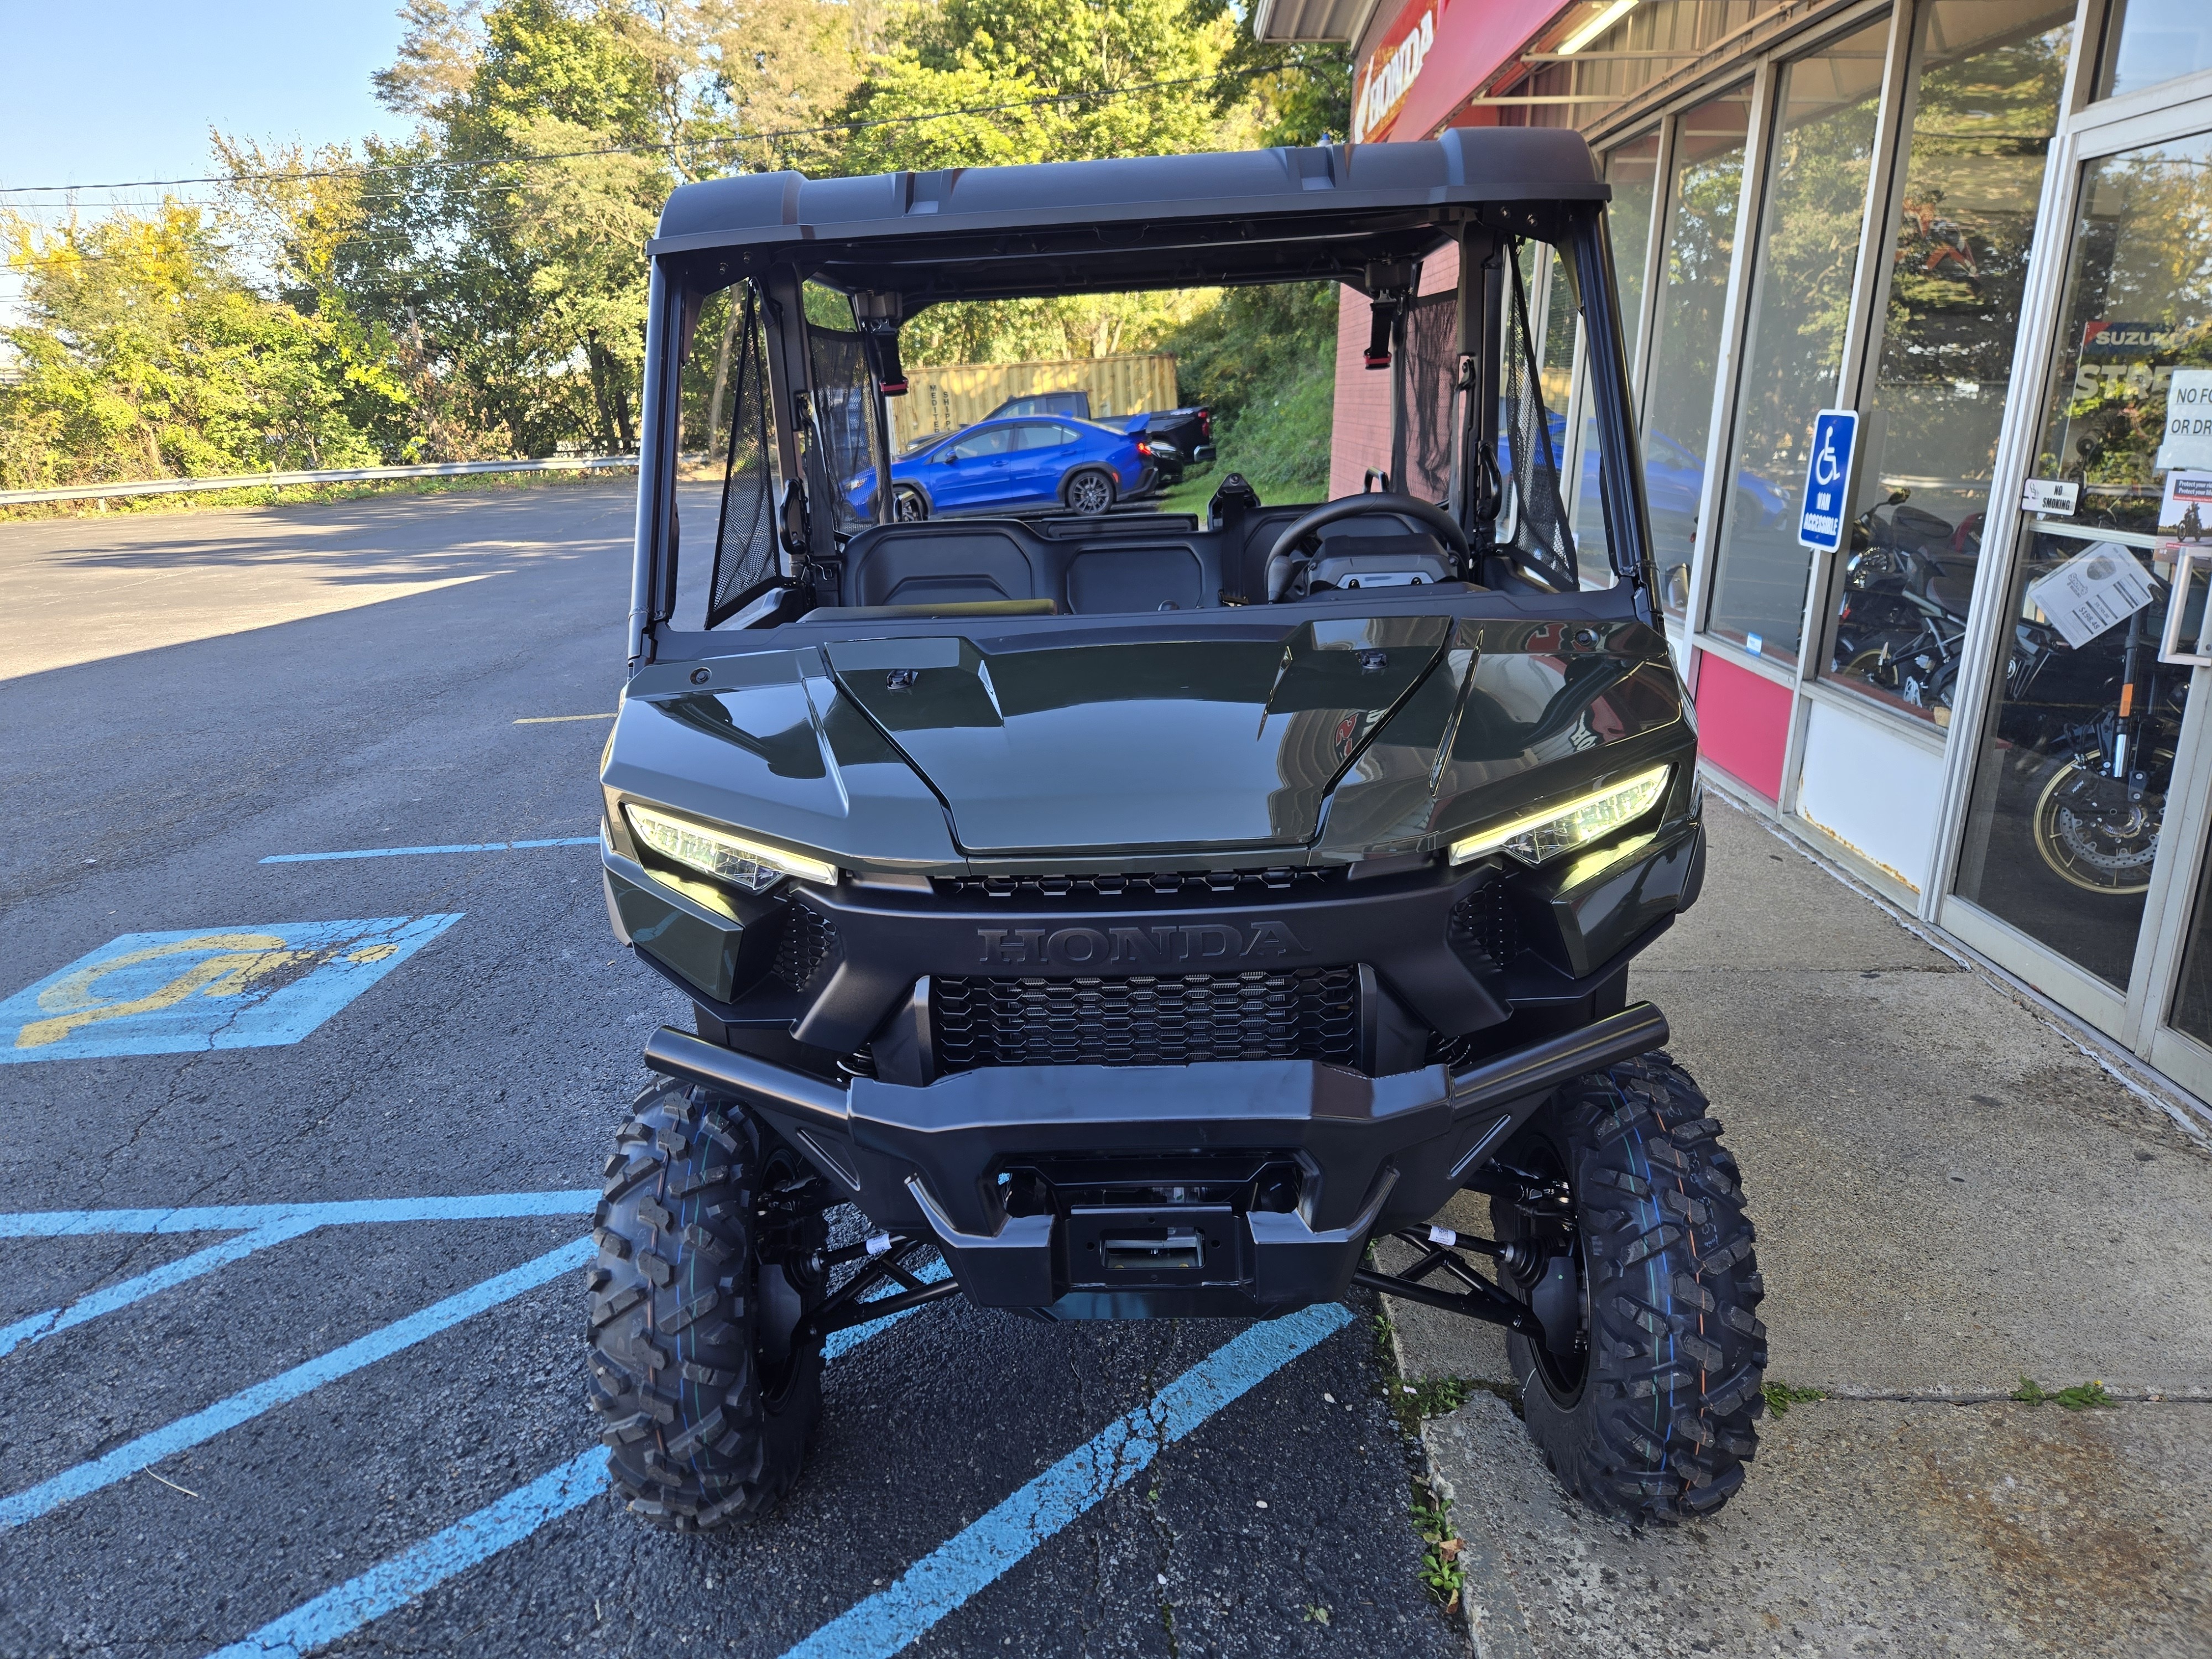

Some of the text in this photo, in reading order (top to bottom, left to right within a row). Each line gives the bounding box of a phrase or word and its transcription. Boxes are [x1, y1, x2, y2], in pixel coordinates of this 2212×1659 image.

[1366, 9, 1434, 133] HONDA
[2095, 331, 2173, 346] SUZU
[2176, 388, 2197, 403] NO
[2171, 419, 2190, 434] OR
[2054, 485, 2063, 495] NO
[1816, 492, 1831, 511] VAN
[2042, 497, 2070, 510] SMOKING
[1803, 512, 1839, 536] ACCESSIBLE
[976, 920, 1312, 966] HONDA
